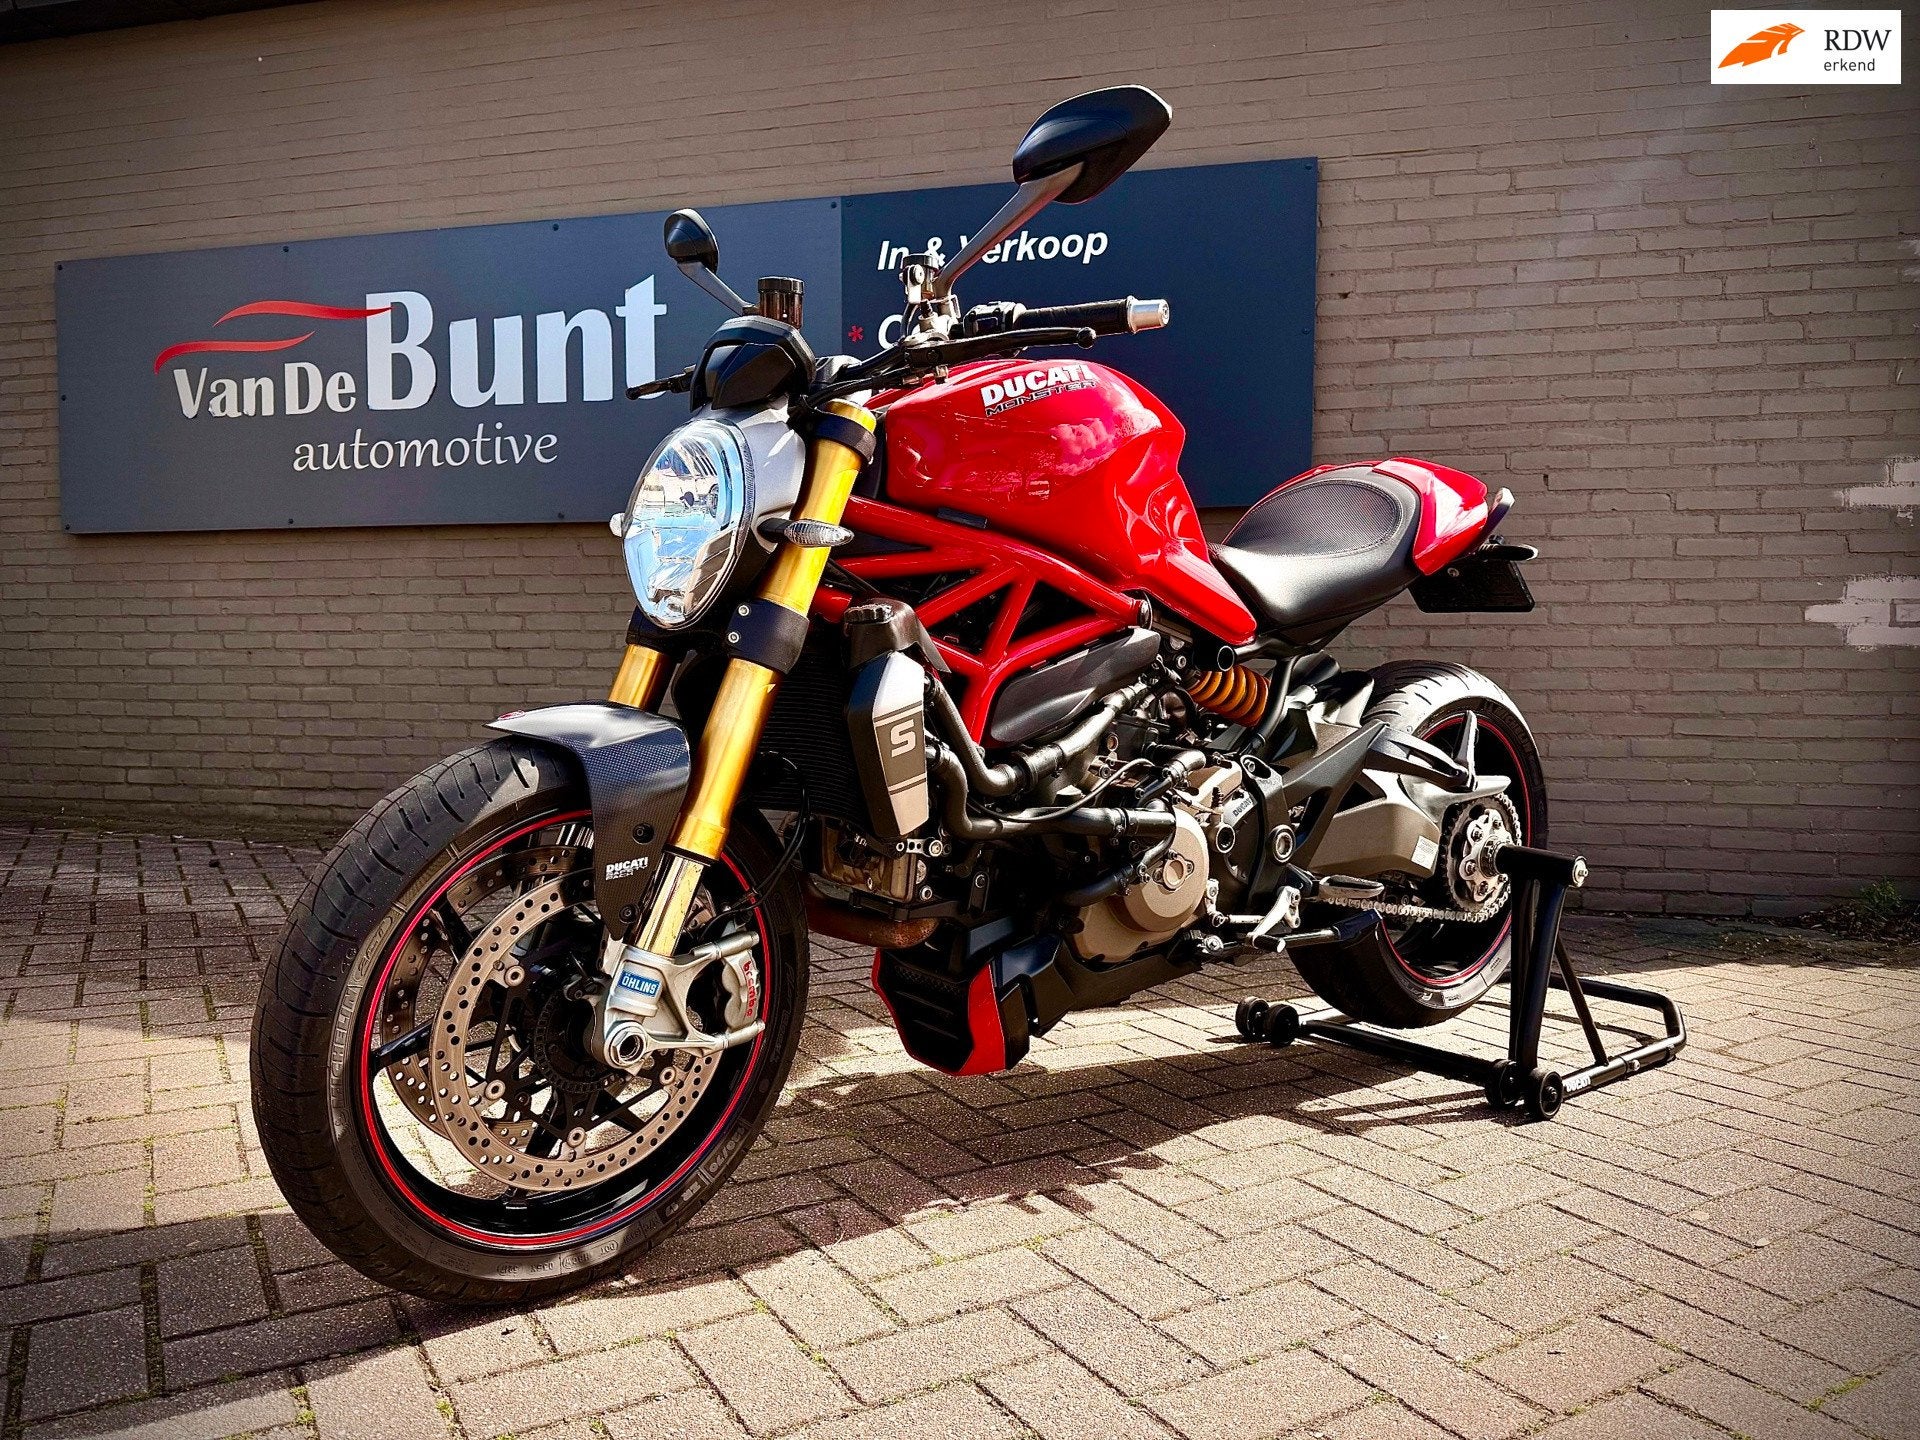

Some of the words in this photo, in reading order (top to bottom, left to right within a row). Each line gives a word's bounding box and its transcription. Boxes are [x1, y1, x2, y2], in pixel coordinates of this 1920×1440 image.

[877, 240, 910, 271] In
[365, 274, 667, 410] Bunt
[981, 364, 1093, 408] DUCATI
[985, 380, 1097, 418] MONSTER
[292, 421, 559, 471] automotive
[890, 718, 916, 758] S
[606, 857, 649, 873] DUCATI
[621, 972, 657, 995] ÖHLINS
[743, 960, 757, 1017] brembo
